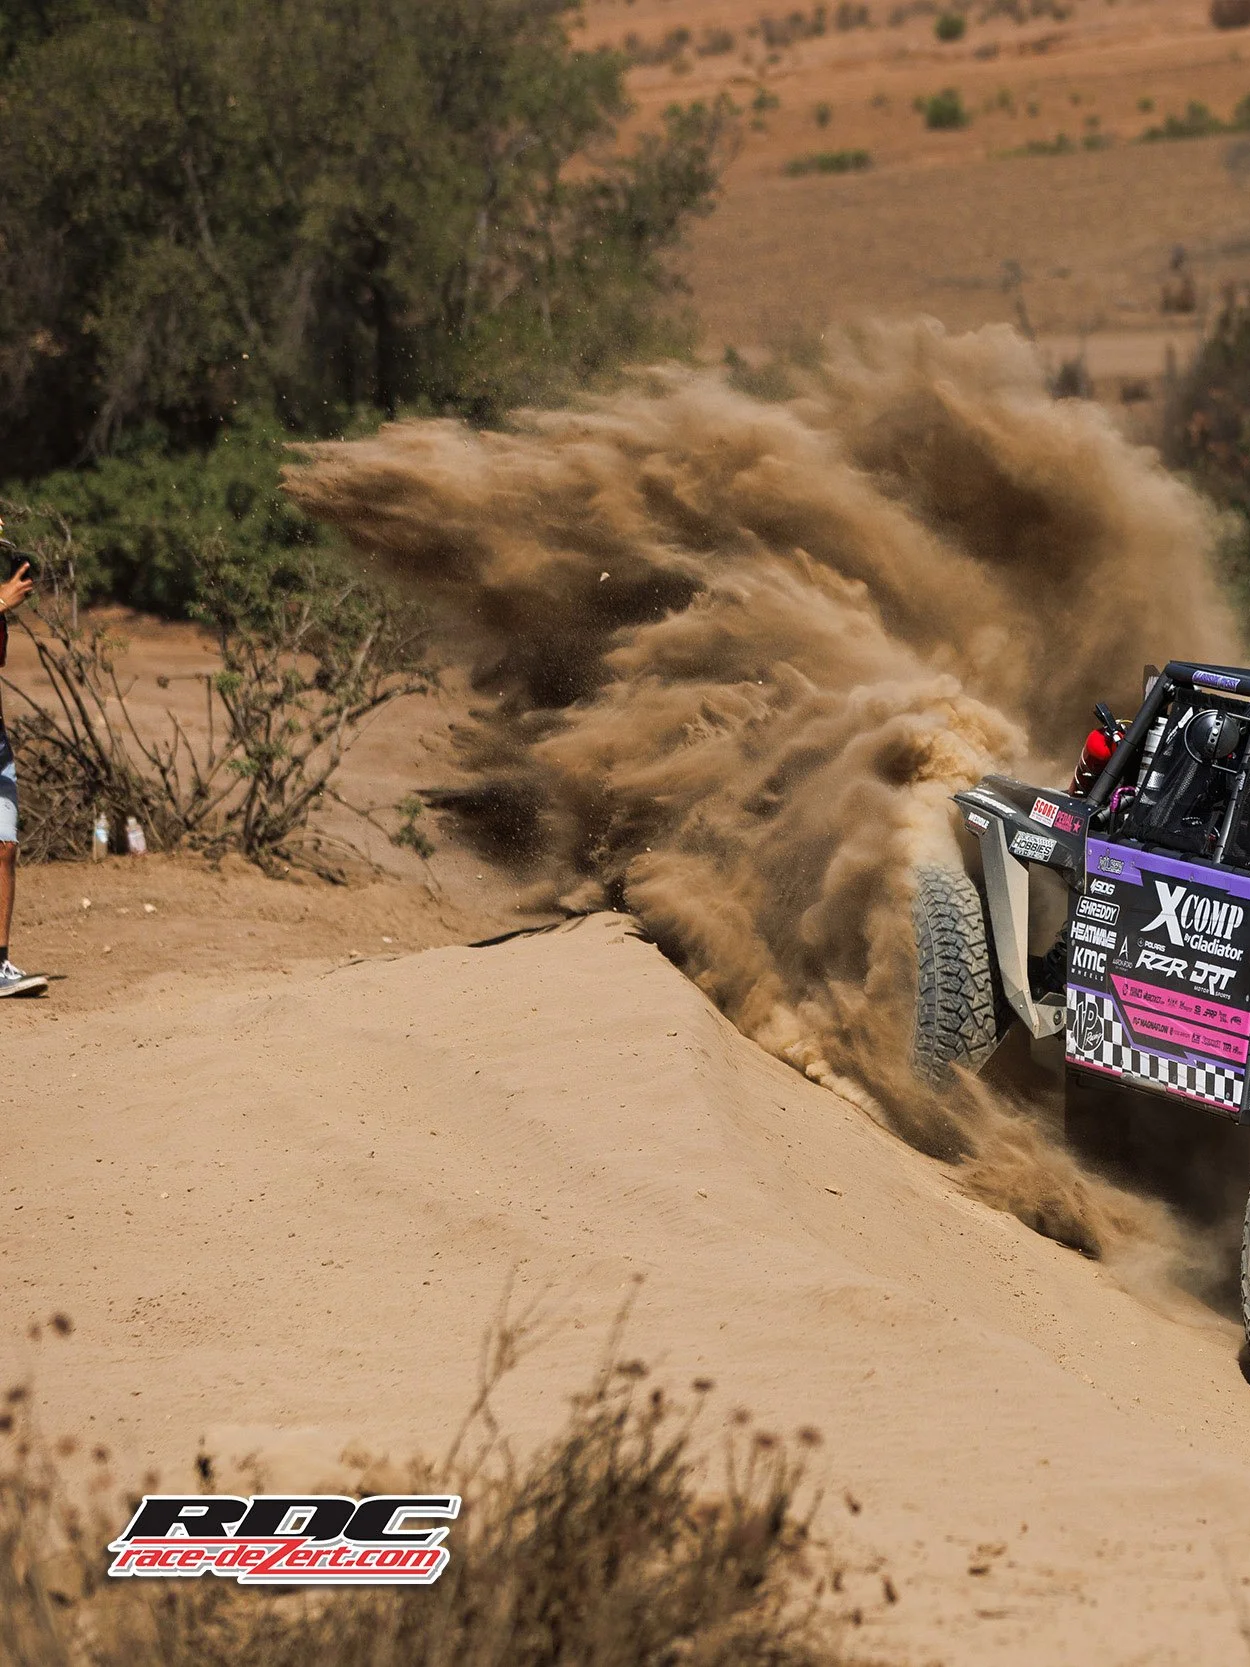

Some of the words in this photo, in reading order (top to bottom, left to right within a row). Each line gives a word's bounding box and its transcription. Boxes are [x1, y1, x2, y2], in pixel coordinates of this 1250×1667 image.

[1033, 800, 1057, 819] SCORE
[1012, 836, 1052, 855] HOBBIES
[1078, 900, 1117, 922] SHREDDY
[1070, 921, 1117, 950] HEATWAVE
[1144, 940, 1166, 952] POLARIS
[1189, 934, 1243, 960] Gladiator
[1072, 946, 1107, 973] KMC
[1134, 949, 1188, 979] RZR
[1071, 968, 1104, 982] WHEELS
[1189, 961, 1237, 995] DRT
[1193, 985, 1210, 994] MOTOR
[1215, 991, 1231, 1000] SPORTS
[1077, 1001, 1099, 1050] VP
